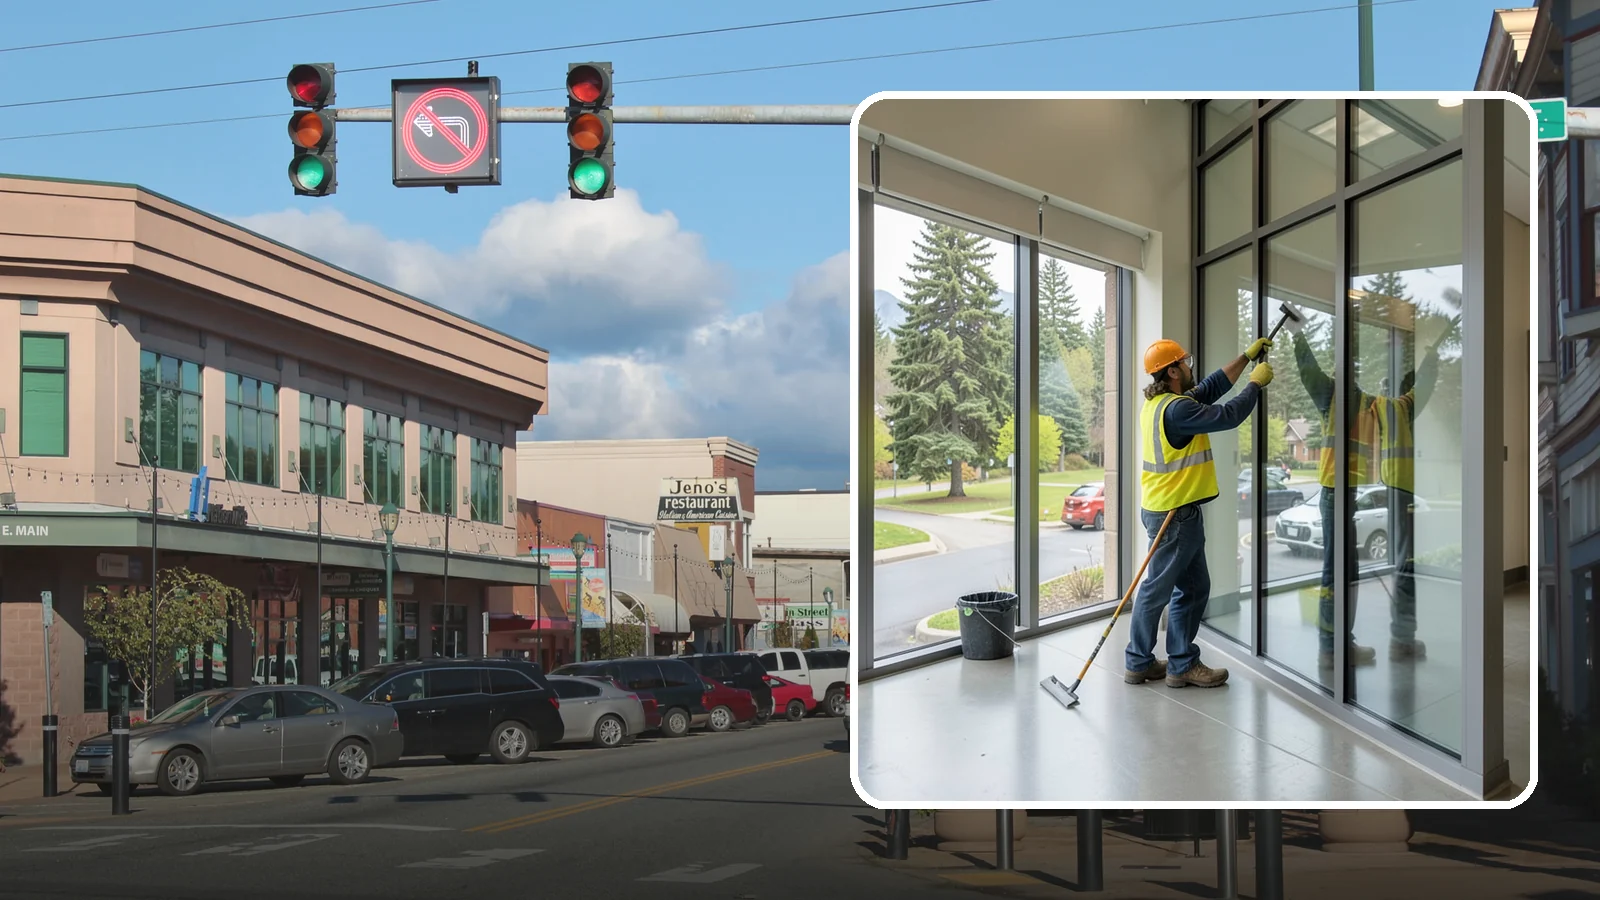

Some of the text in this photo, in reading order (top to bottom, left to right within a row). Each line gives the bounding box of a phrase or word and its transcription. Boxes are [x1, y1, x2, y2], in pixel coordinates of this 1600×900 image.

[670, 480, 727, 494] Jeno's
[665, 497, 731, 509] restaurant
[658, 510, 681, 519] Italian
[686, 510, 715, 519] American
[715, 510, 737, 519] Cuisine
[2, 525, 49, 536] E. MAIN
[797, 608, 829, 617] Street
[790, 619, 824, 627] lass
